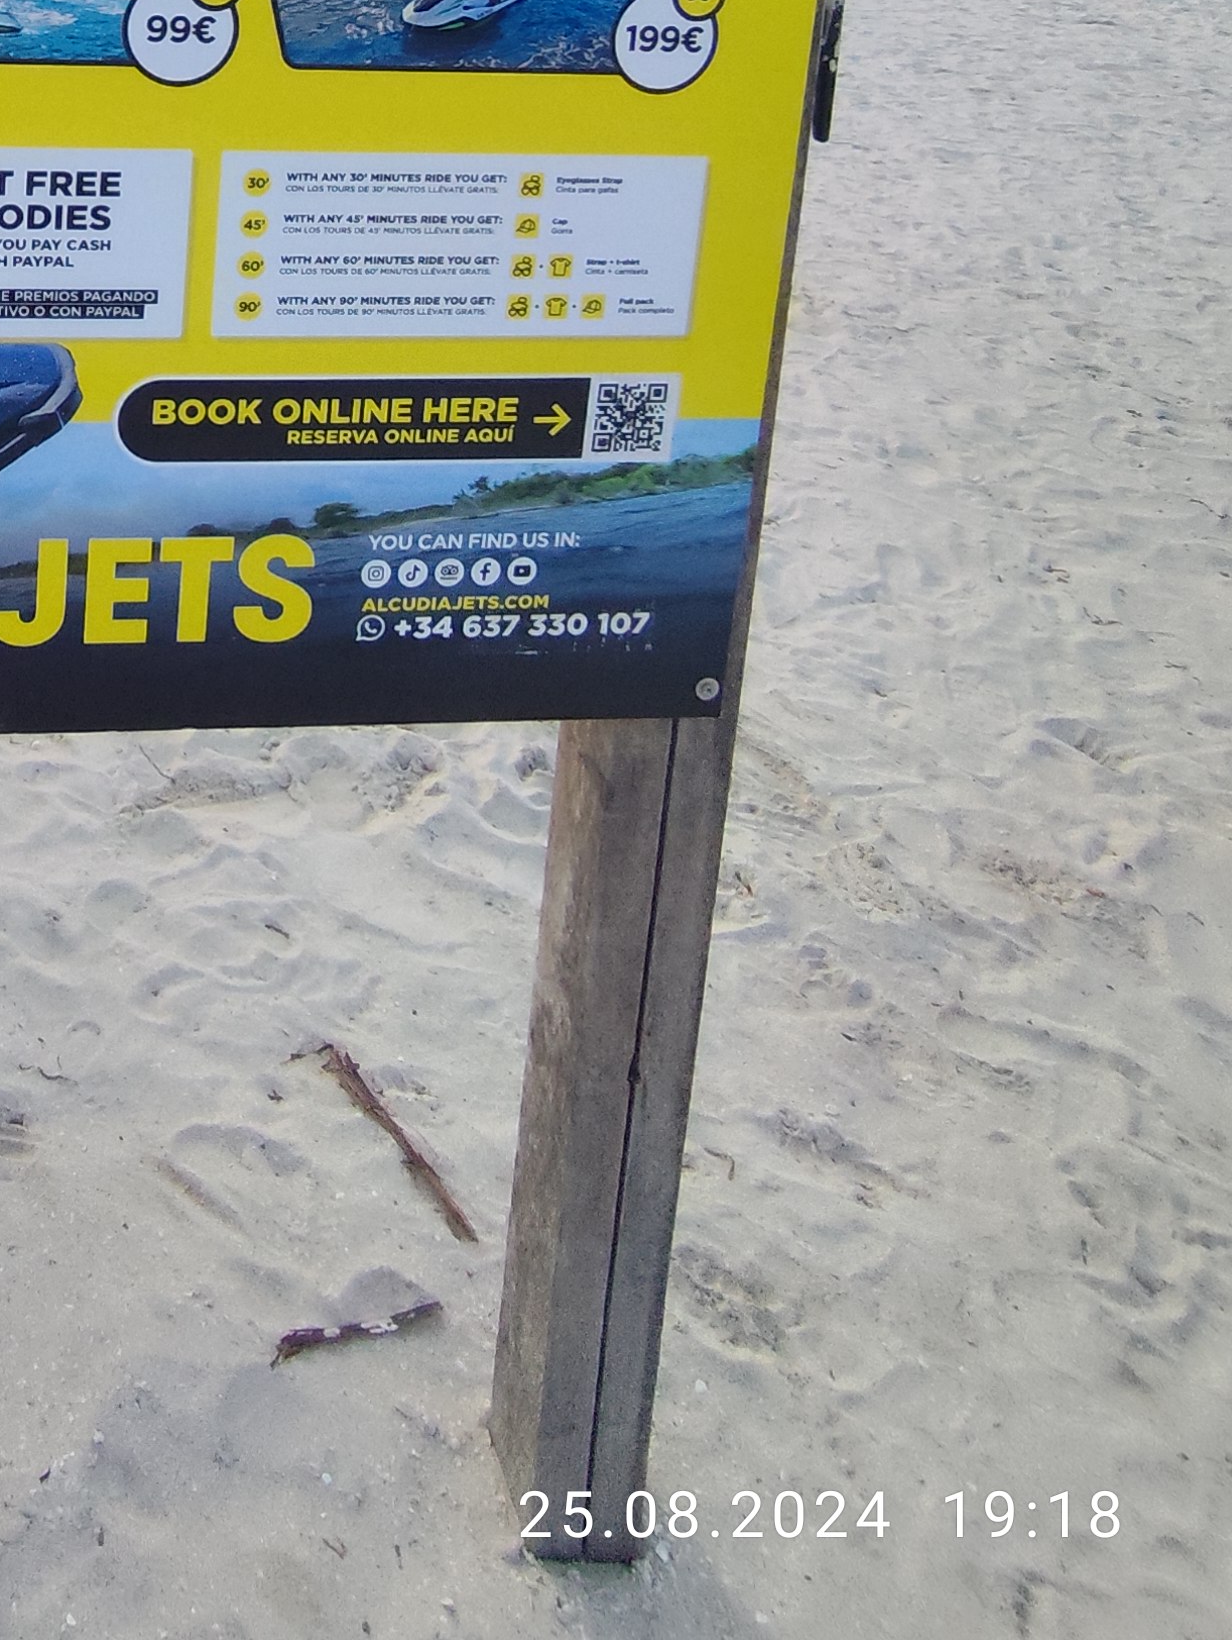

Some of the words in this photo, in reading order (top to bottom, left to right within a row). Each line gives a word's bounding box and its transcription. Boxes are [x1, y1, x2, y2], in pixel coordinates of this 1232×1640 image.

[145, 14, 218, 46] 99€
[625, 24, 704, 54] 199€
[25, 170, 122, 198] FREE
[287, 172, 319, 182] WITH
[321, 172, 347, 182] ANY
[370, 173, 421, 183] MINUTES
[425, 174, 452, 183] RIDE
[455, 174, 479, 183] YOU
[283, 214, 315, 223] WITH
[317, 214, 343, 223] ANY
[367, 215, 417, 224] MINUTES
[420, 215, 448, 225] RIDE
[450, 216, 475, 225] YOU
[31, 239, 63, 252] PAY
[67, 239, 112, 252] CASH
[12, 256, 75, 268] PAYPAL
[14, 290, 80, 303] PREMIOS
[82, 291, 156, 303] PAGANDO
[277, 296, 309, 305] WITH
[310, 296, 336, 305] ANY
[360, 296, 411, 305] MINUTES
[413, 297, 441, 306] RIDE
[443, 297, 468, 306] YOU
[33, 306, 47, 317] O
[49, 306, 82, 318] CON
[85, 306, 140, 318] PAYPAL
[152, 397, 263, 427] BOOK
[271, 396, 414, 426] ONLINE
[421, 396, 520, 424] HERE
[286, 429, 379, 447] RESERVA
[383, 427, 460, 446] ONLINE
[463, 424, 515, 445] AQUÍ
[368, 534, 414, 552] YOU
[418, 534, 463, 551] CAN
[468, 533, 518, 550] FIND
[522, 532, 551, 549] US
[553, 532, 581, 548] IN:
[361, 594, 550, 613] ALCUDIAJETS.COM
[393, 615, 453, 640] +34
[462, 614, 520, 638] 637
[527, 612, 589, 637] 330
[597, 611, 651, 636] 107
